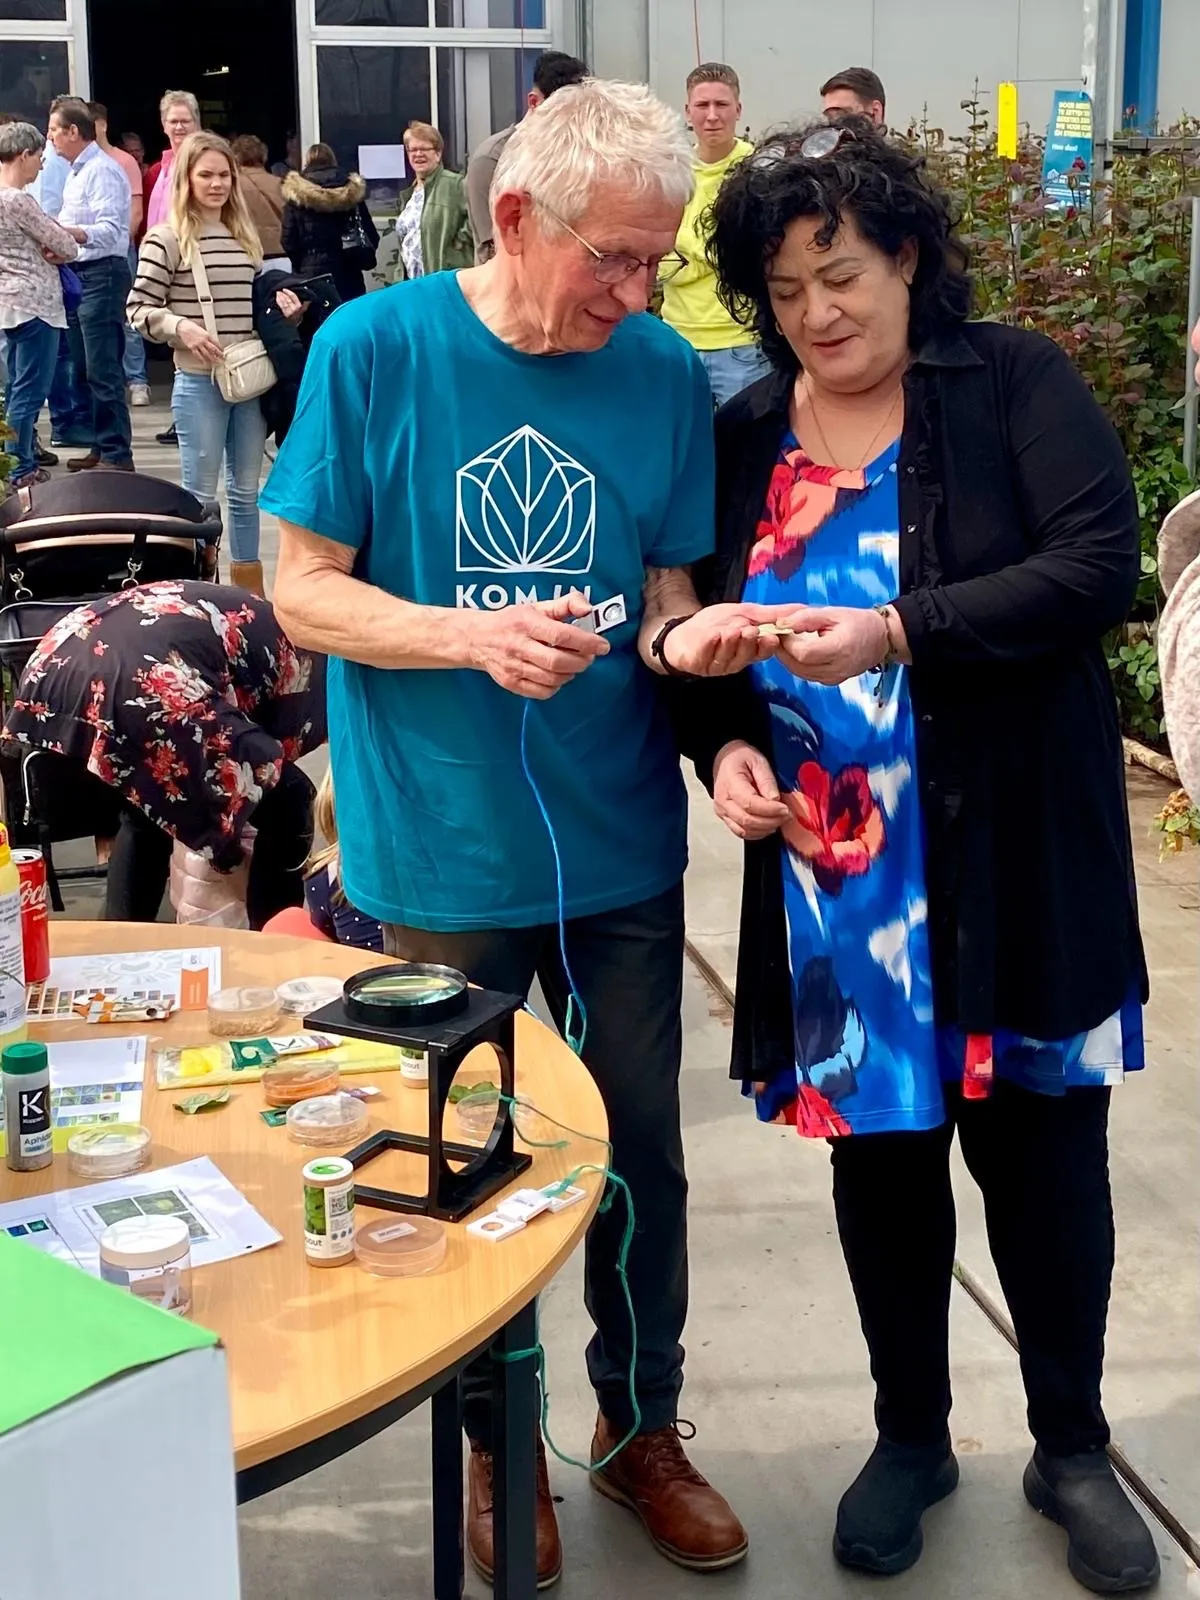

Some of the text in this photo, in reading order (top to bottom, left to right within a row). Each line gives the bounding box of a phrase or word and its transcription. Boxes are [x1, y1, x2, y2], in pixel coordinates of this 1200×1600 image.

[456, 583, 591, 610] KOM IN
[22, 1091, 44, 1117] K
